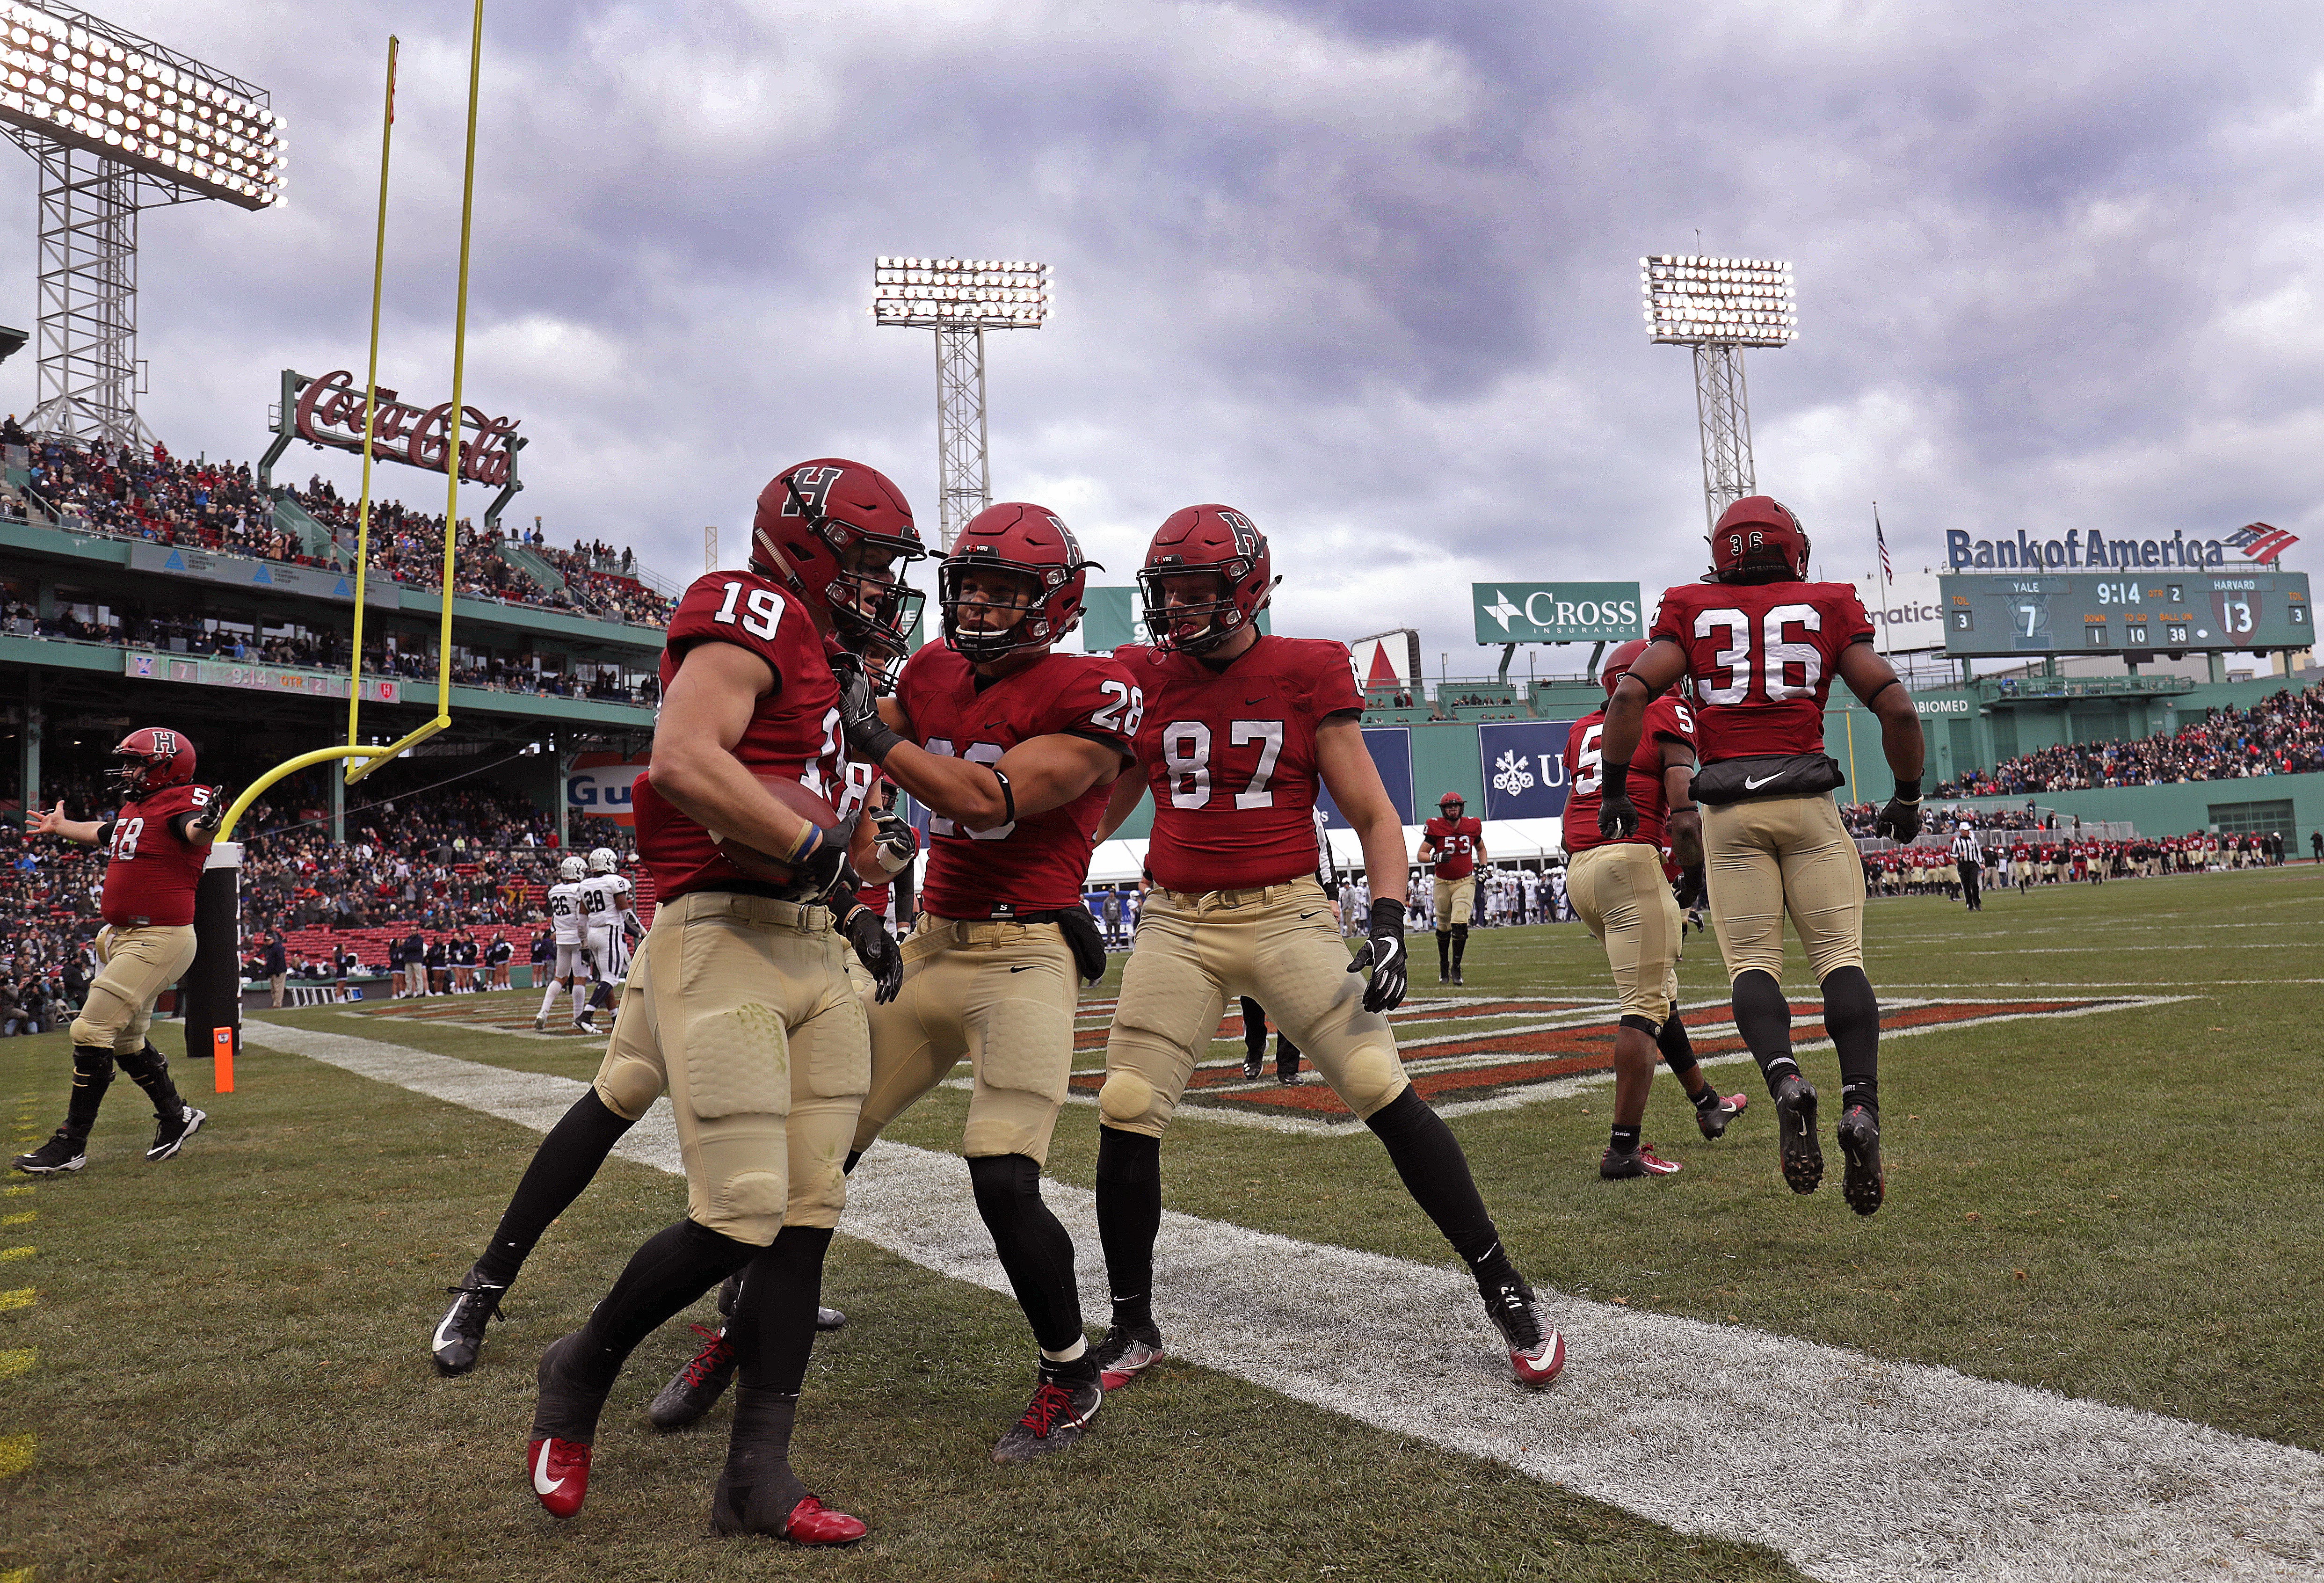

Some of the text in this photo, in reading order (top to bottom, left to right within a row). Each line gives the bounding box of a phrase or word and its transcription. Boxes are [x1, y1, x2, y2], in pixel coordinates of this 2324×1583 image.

[781, 467, 843, 517] H
[1217, 512, 1264, 559] H
[1730, 532, 1763, 556] 36
[1946, 529, 2224, 568] Bank of America
[2013, 582, 2040, 593] YALE
[2097, 582, 2141, 604] 9:14
[2172, 588, 2180, 602] 2
[2214, 580, 2255, 590] HARVARD
[1953, 596, 1970, 606] TOL
[2288, 592, 2304, 601] TOL
[714, 581, 786, 641] 19
[2084, 614, 2106, 623] DOWN
[2124, 613, 2148, 622] TO GO
[2159, 613, 2180, 621] BALL
[2223, 602, 2253, 633] 13
[2294, 609, 2303, 623] 3
[1958, 614, 1968, 629] 3
[2020, 606, 2035, 638] 7
[2094, 629, 2100, 644] 1
[2130, 629, 2145, 643] 10
[2170, 628, 2187, 643] 38
[1693, 603, 1822, 706] 36
[233, 668, 267, 686] 9:14
[281, 675, 302, 688] QTR
[1090, 680, 1144, 737] 28
[1674, 704, 1695, 734] 5
[152, 731, 176, 754] H
[1162, 720, 1285, 810] 87
[109, 817, 145, 860] 58
[1444, 835, 1471, 855] 53
[552, 895, 571, 916] 26
[584, 889, 606, 913] 28
